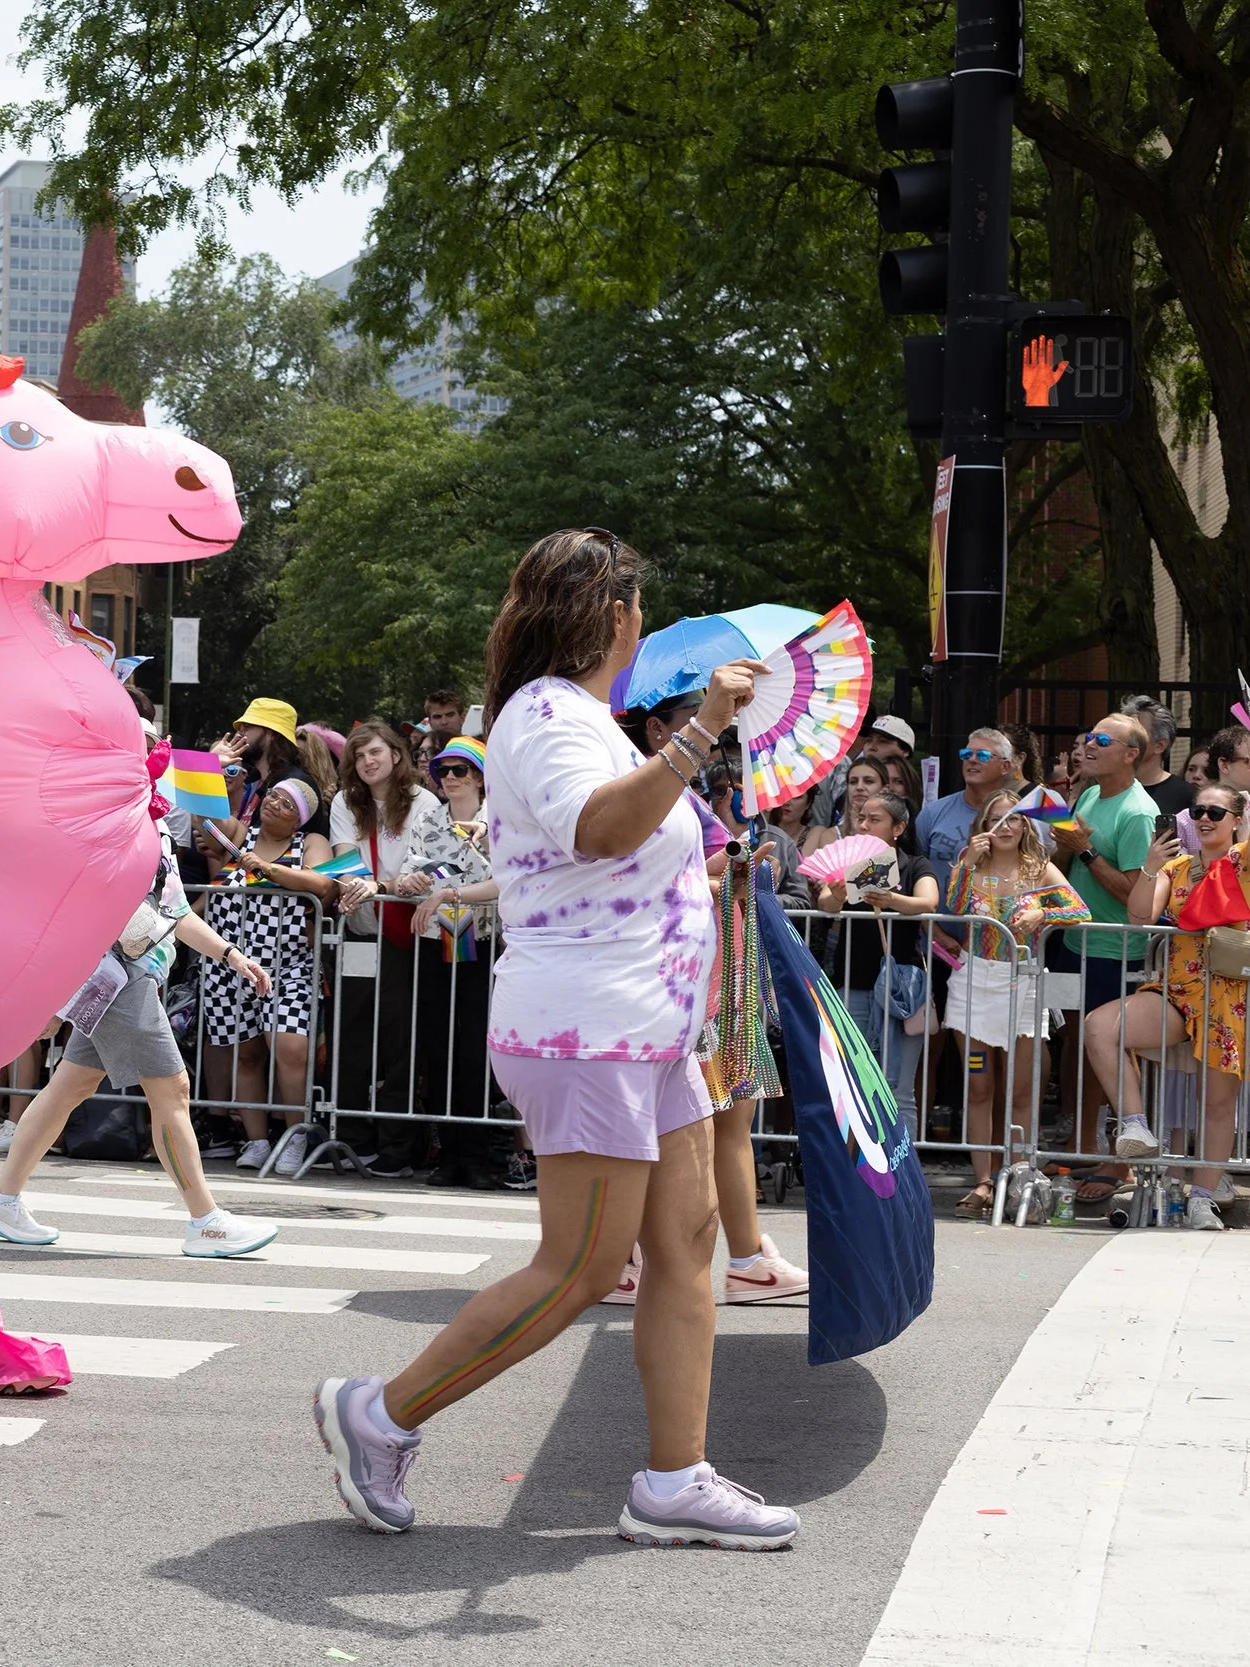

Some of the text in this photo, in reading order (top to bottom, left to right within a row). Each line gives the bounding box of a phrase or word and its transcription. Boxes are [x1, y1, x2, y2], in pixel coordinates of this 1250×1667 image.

[78, 989, 106, 1024] STAY COOL
[201, 1229, 227, 1239] HOKA
